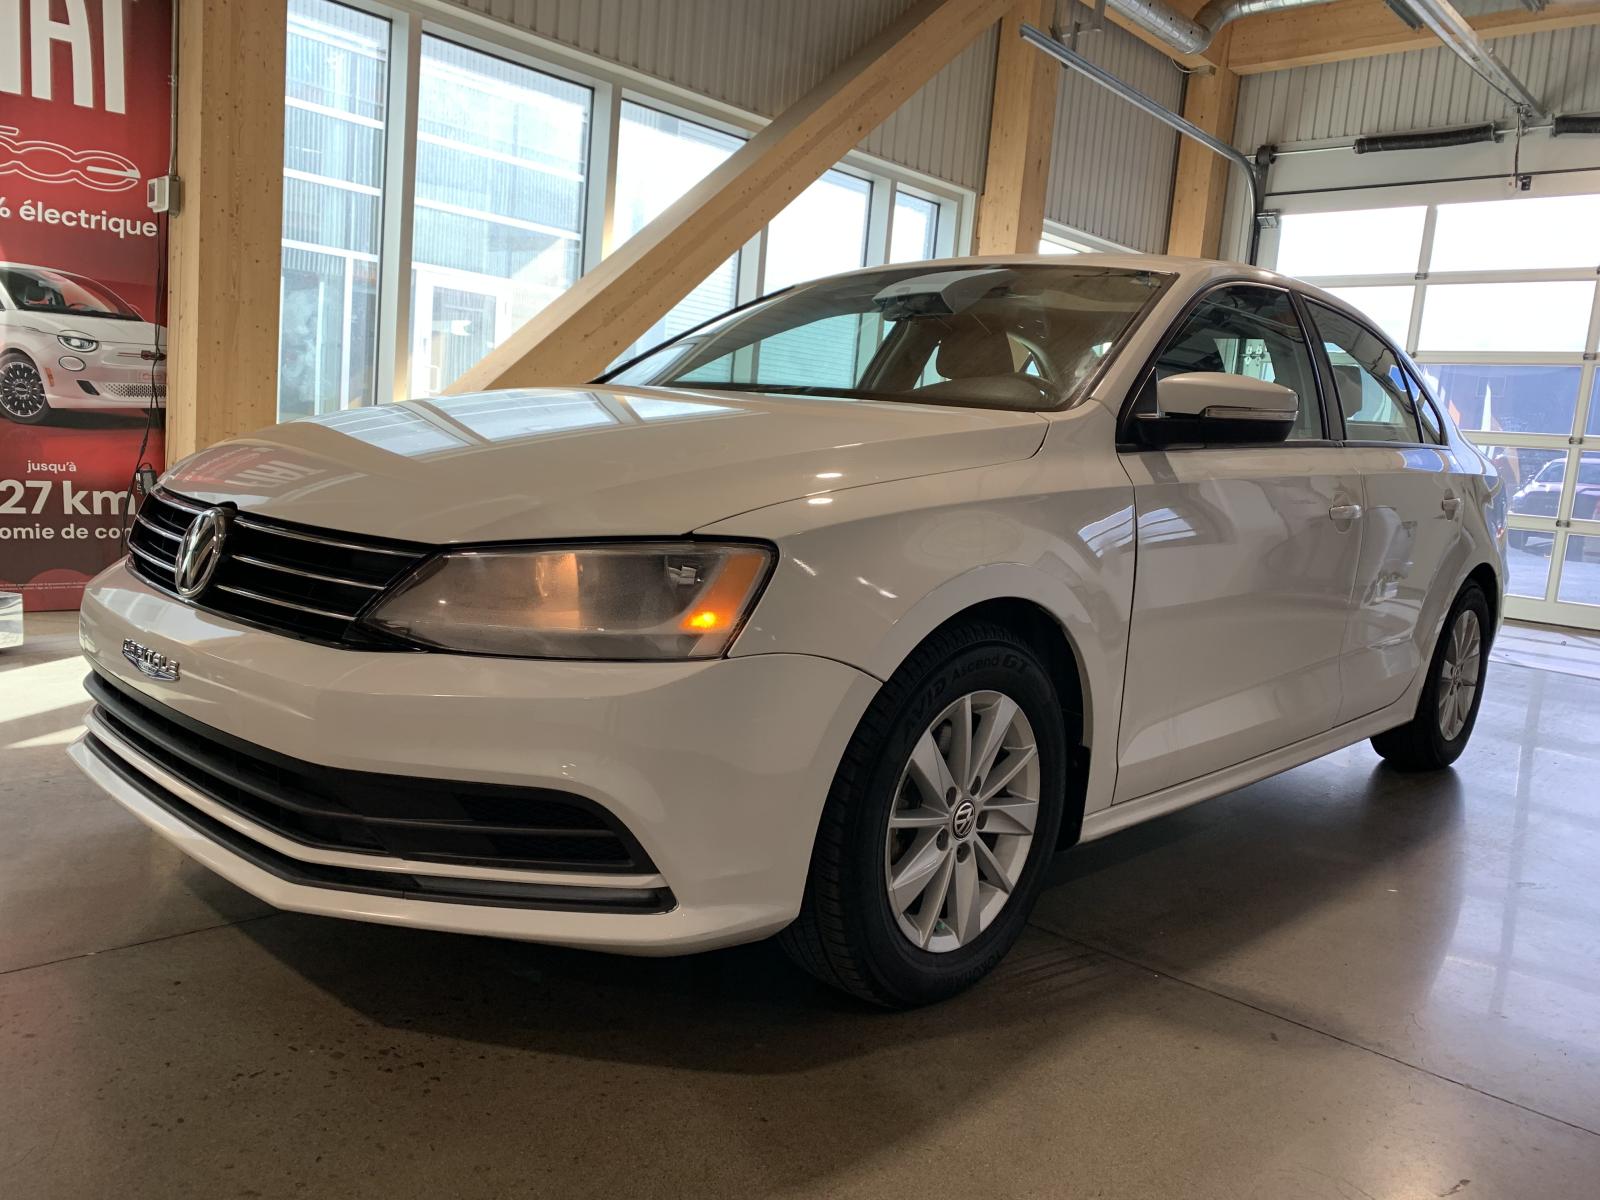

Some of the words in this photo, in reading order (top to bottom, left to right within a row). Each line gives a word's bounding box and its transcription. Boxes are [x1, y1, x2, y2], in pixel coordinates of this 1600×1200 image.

[19, 200, 157, 238] électrique
[27, 460, 77, 474] jusqu'à
[62, 481, 136, 515] km
[61, 523, 89, 540] de
[1002, 653, 1028, 675] GT
